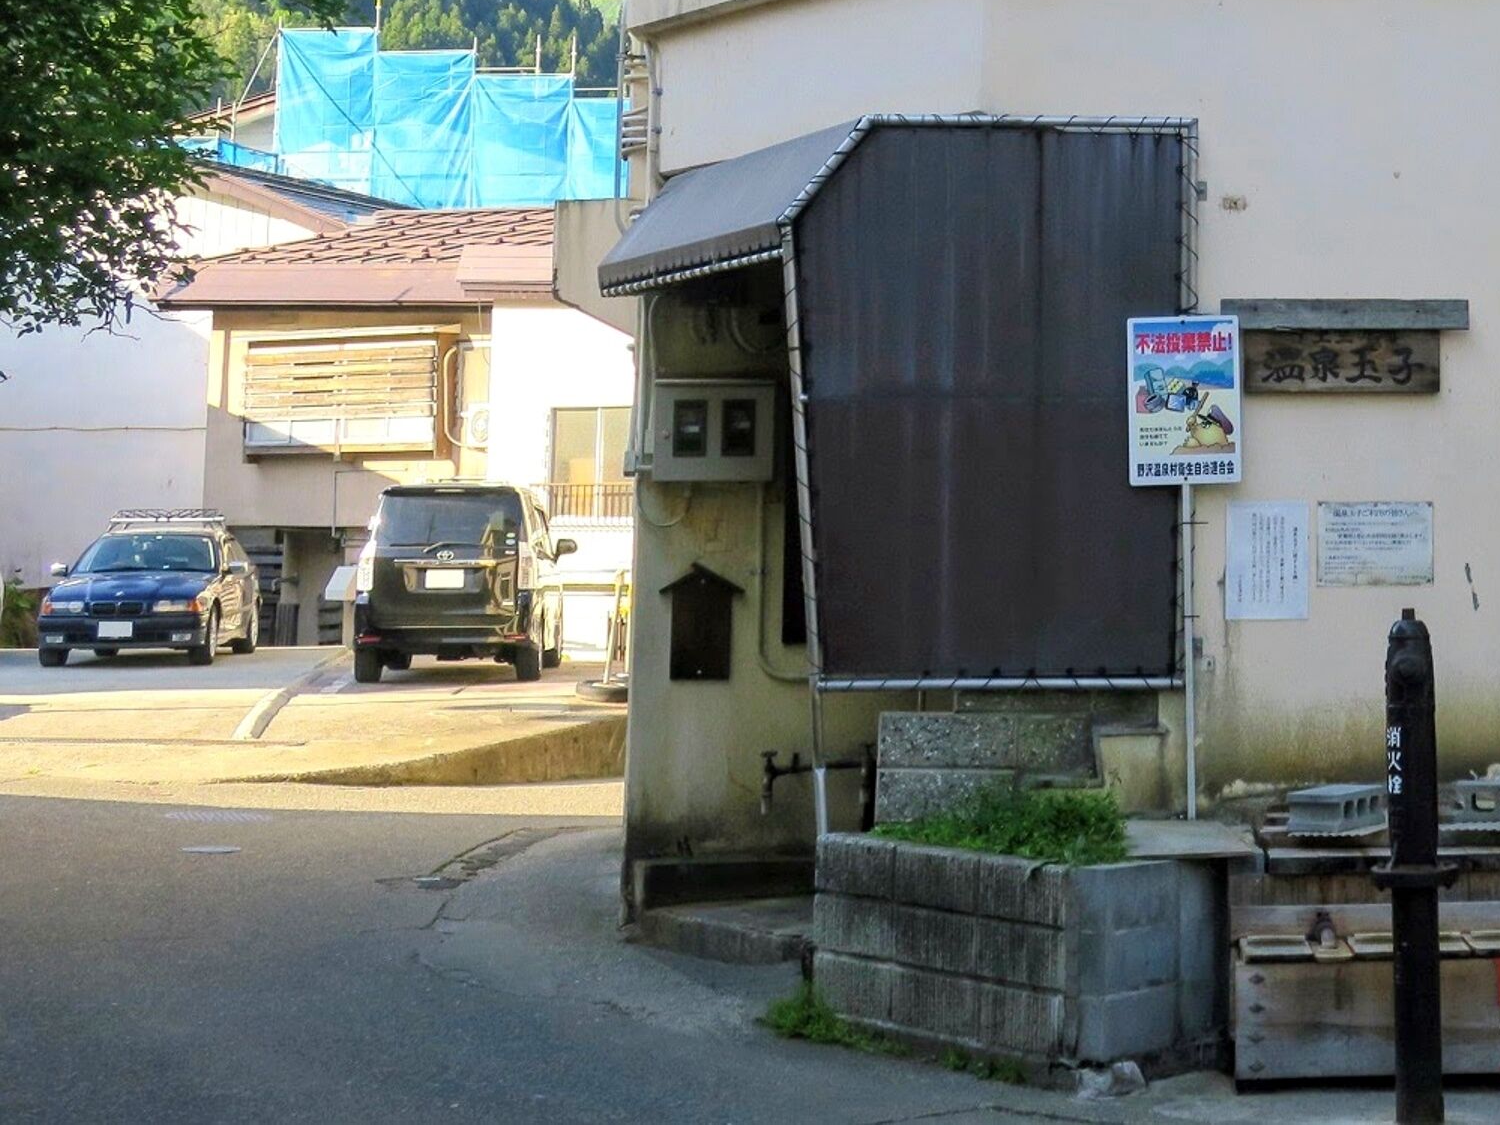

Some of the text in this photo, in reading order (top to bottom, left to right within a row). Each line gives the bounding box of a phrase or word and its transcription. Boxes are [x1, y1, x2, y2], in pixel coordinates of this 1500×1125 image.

[1135, 331, 1232, 354] 不法投棄禁止!
[1261, 347, 1425, 385] 温泉玉子
[1386, 726, 1403, 794] 消火栓
